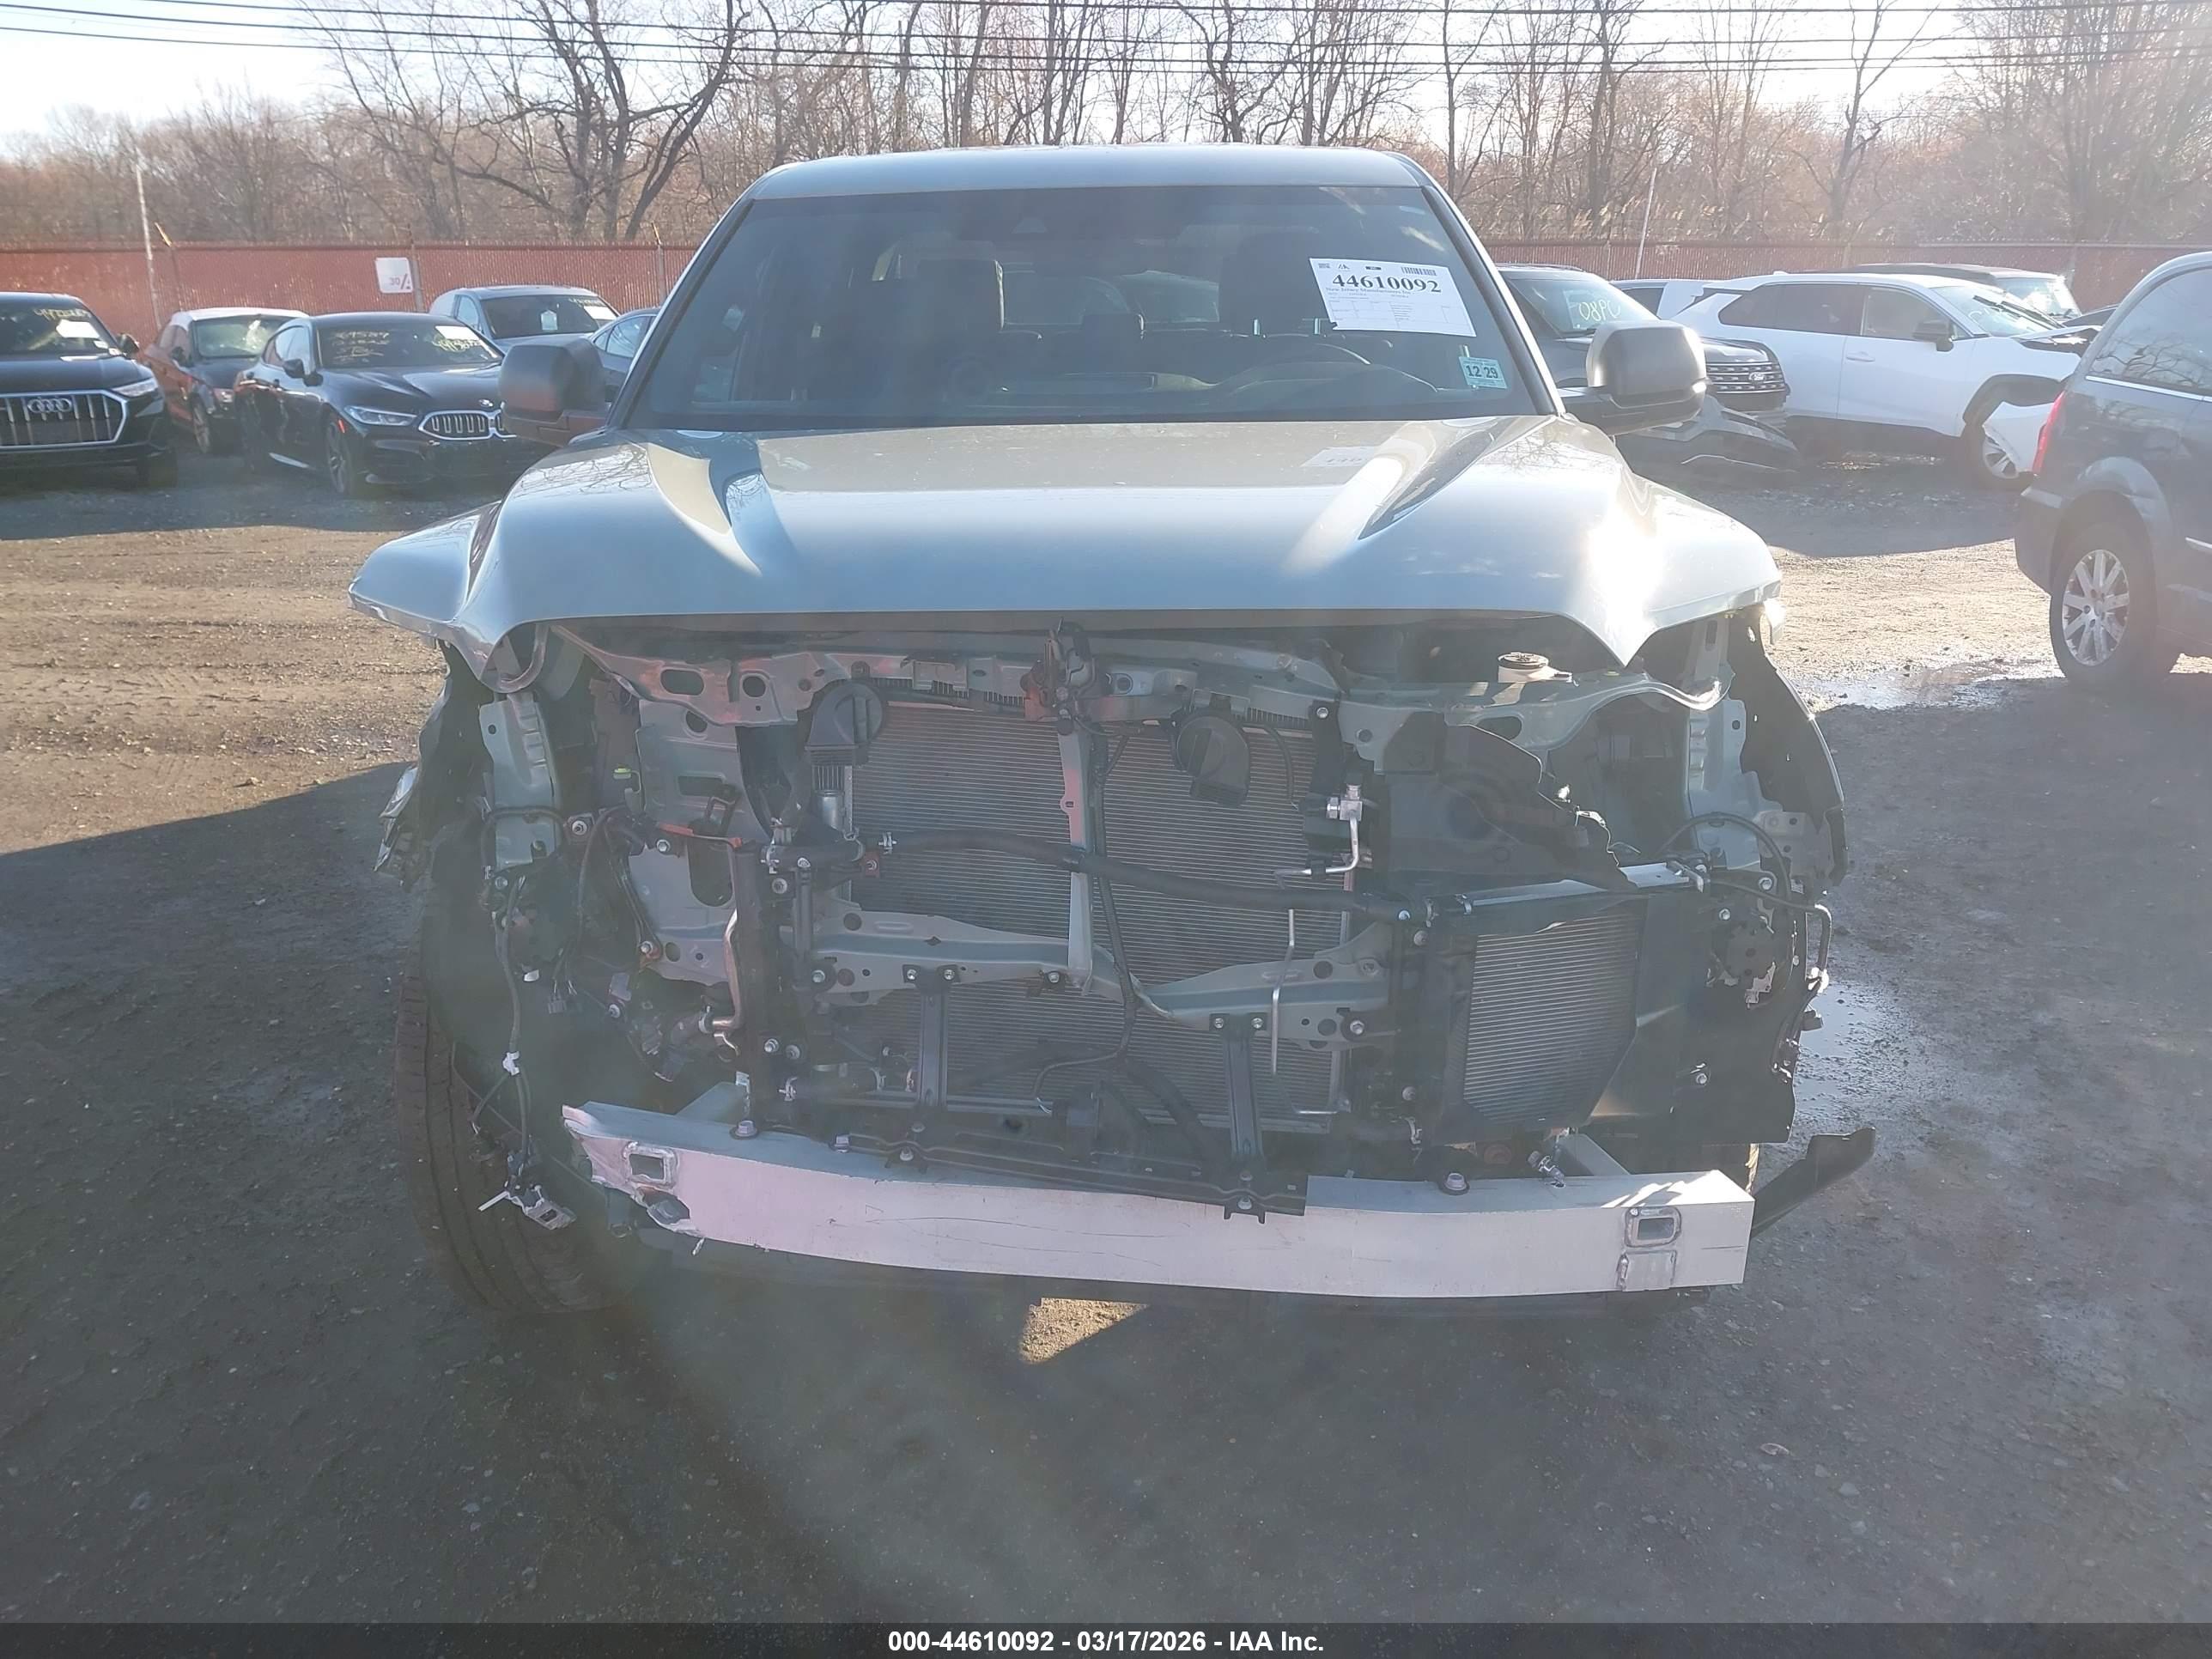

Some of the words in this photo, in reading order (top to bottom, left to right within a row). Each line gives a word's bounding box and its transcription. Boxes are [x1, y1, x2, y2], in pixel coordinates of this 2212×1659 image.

[1333, 274, 1441, 293] 44610092
[1465, 365, 1482, 377] 12
[1483, 367, 1498, 379] 29
